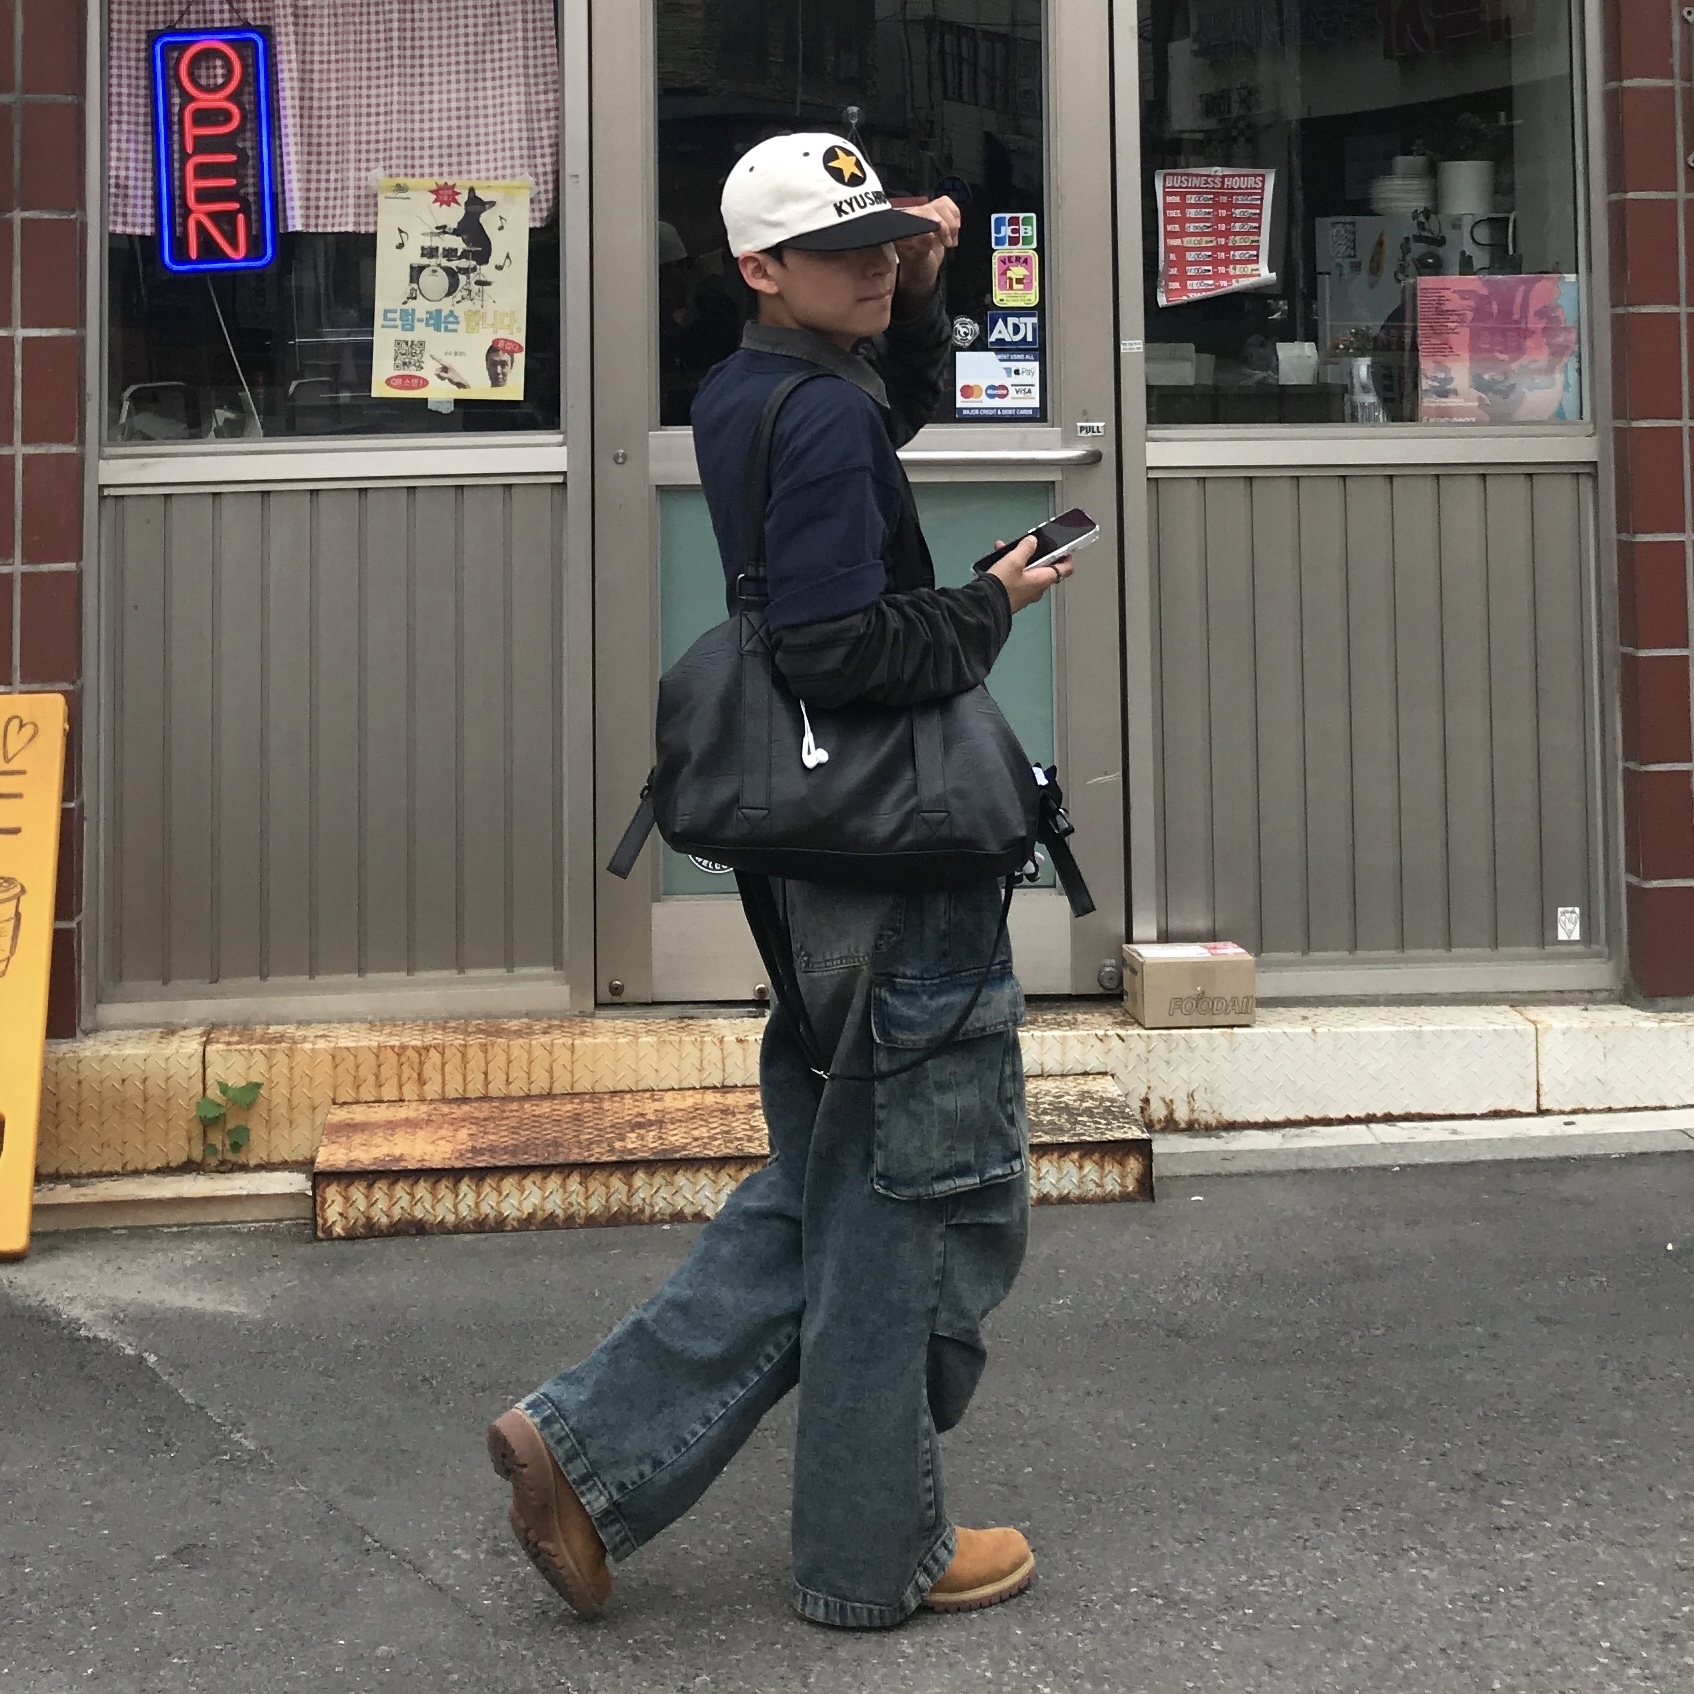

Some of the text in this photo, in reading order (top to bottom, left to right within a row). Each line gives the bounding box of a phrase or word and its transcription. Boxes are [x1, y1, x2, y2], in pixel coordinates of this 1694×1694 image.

[178, 40, 247, 260] OPEN
[1165, 175, 1263, 189] BUSINESS HOURS
[1000, 255, 1029, 266] VERA
[381, 308, 460, 333] 드럼-레슨
[989, 316, 1037, 342] ADT
[1020, 366, 1036, 378] Pay
[1014, 387, 1032, 395] VISA
[1079, 425, 1102, 434] PULL
